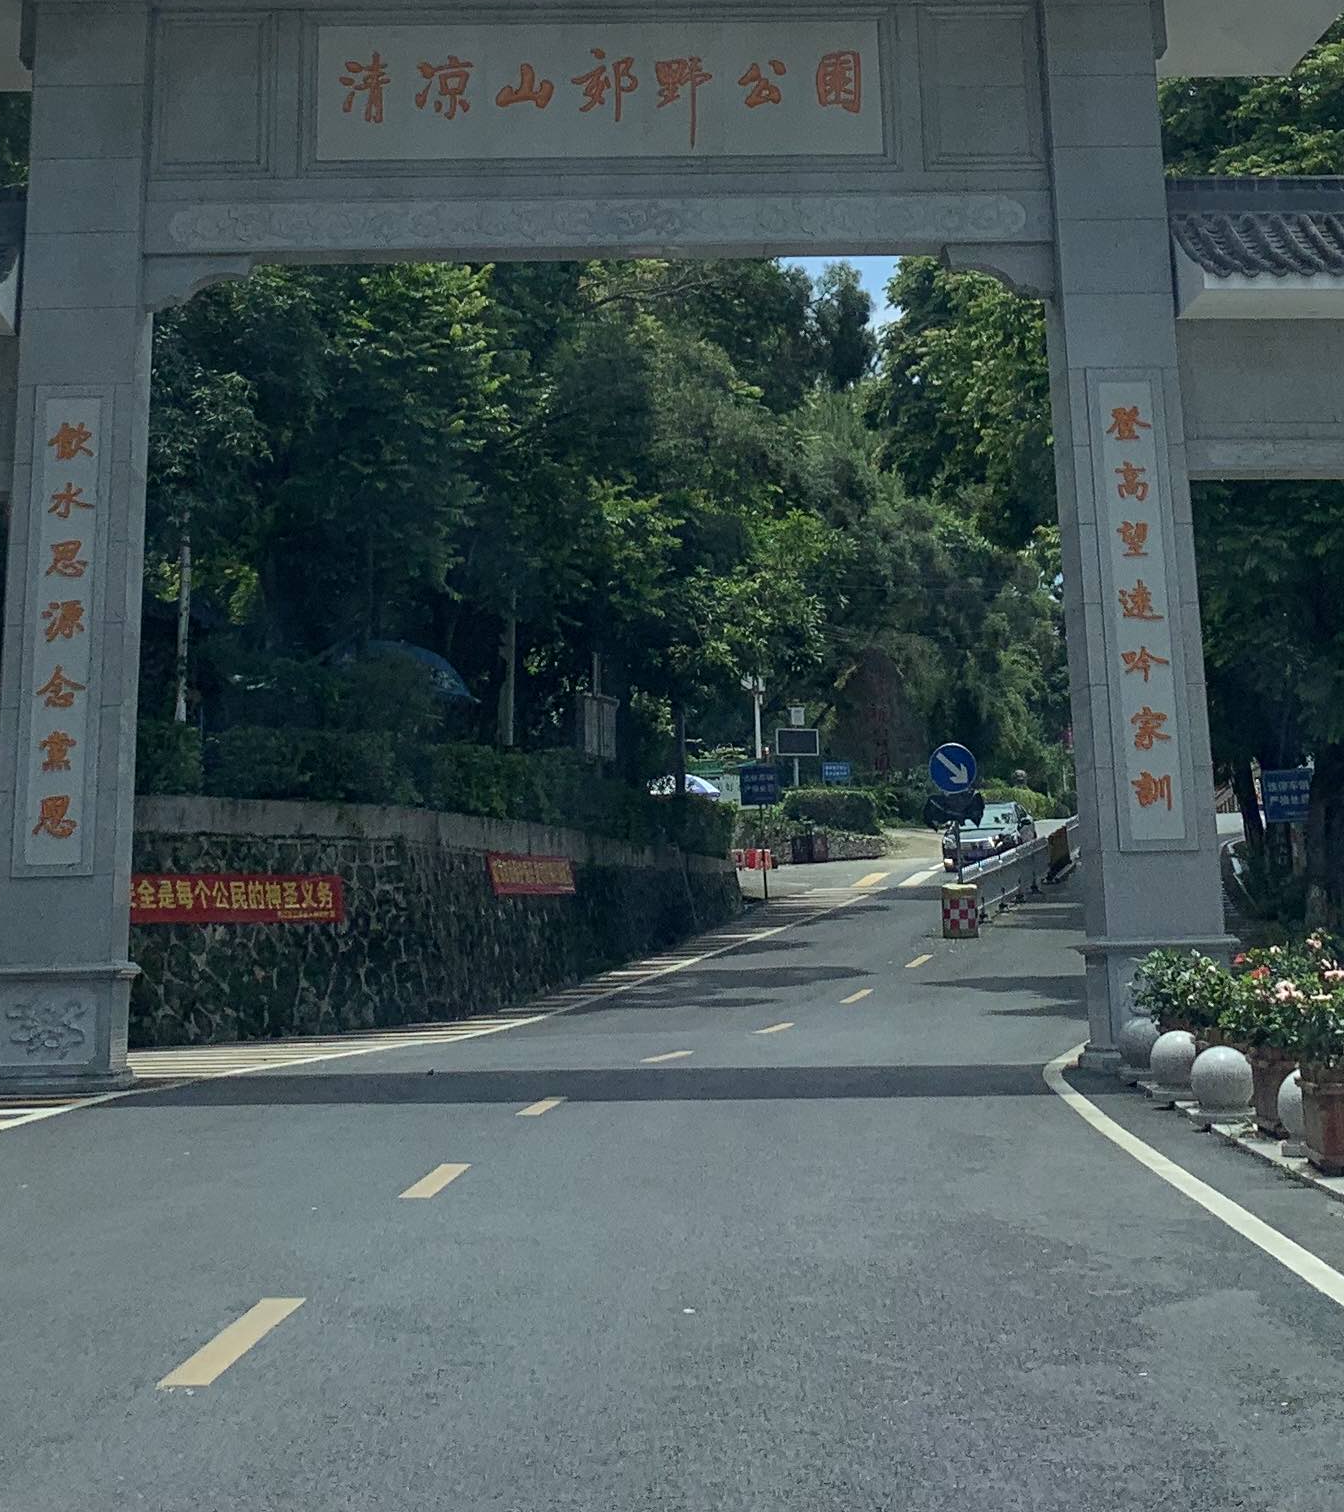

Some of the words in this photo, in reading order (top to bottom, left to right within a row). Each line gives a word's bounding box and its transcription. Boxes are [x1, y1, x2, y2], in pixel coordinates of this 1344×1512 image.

[130, 879, 333, 910] 全是每个公民的神圣义务
